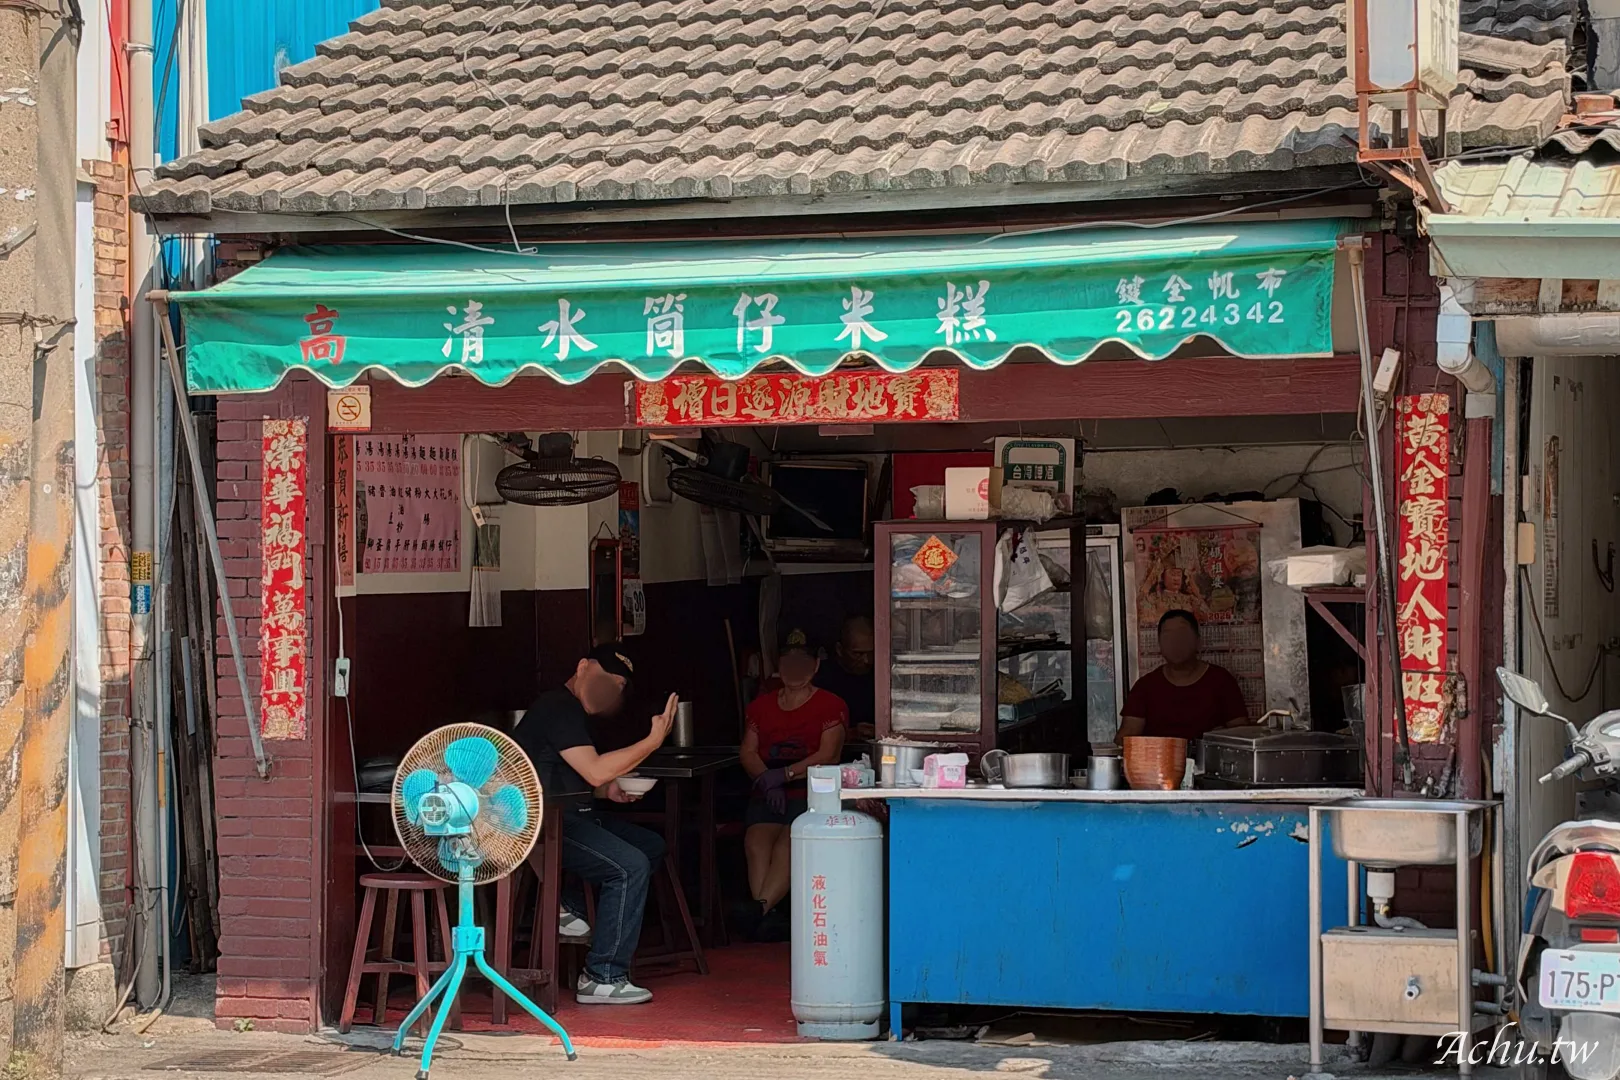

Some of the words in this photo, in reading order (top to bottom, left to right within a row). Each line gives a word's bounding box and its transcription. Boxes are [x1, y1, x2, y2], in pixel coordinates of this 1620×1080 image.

[300, 304, 346, 365] 高
[441, 280, 997, 364] 清水筒仔米糕
[1116, 301, 1284, 333] 26224342
[633, 590, 645, 612] 30
[811, 874, 829, 967] 液化石油氣
